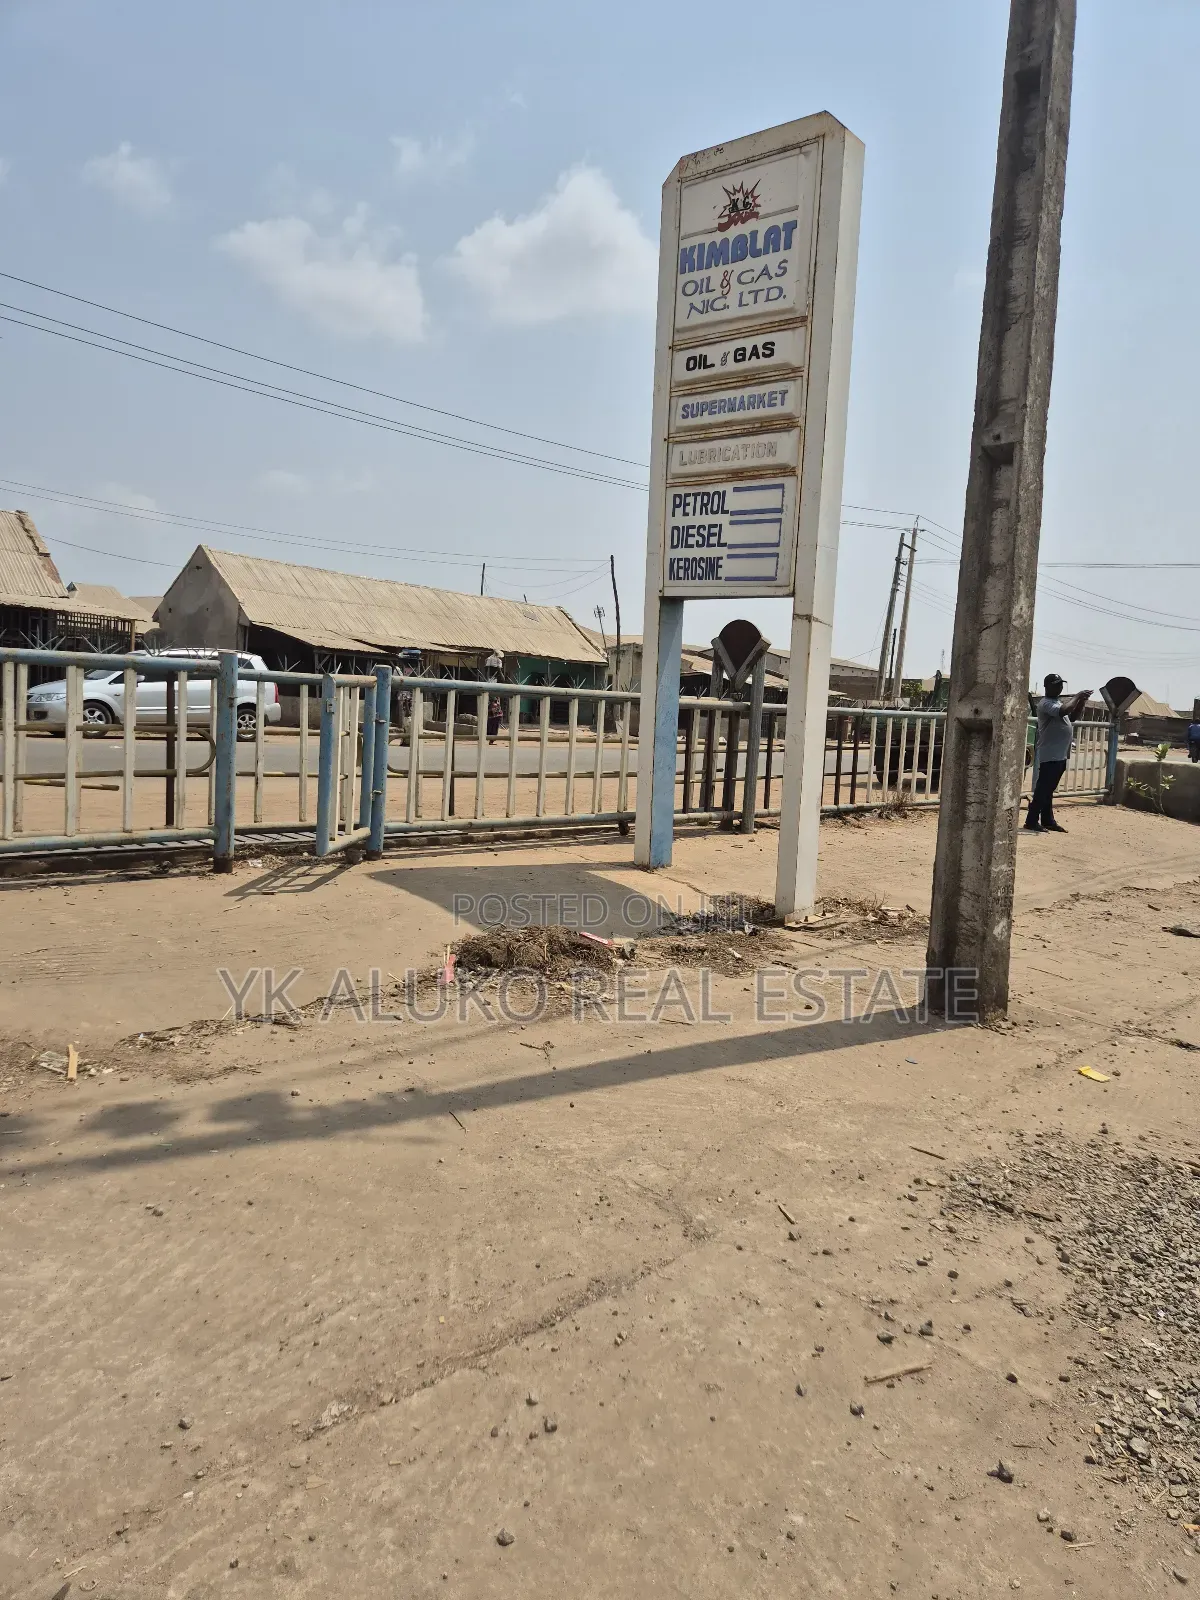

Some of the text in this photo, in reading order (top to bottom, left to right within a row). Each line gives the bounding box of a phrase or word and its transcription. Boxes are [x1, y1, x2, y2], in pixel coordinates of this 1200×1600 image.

[679, 219, 798, 275] KIMBLAT
[681, 258, 789, 297] OIL & GAS
[738, 285, 787, 308] LTD.
[685, 353, 715, 372] OIL
[733, 341, 776, 364] GAS
[681, 389, 789, 420] SUPERMARKET
[678, 441, 778, 467] LUBRICATION
[671, 490, 730, 518] PETROL
[670, 523, 728, 550] DIESEL
[668, 556, 724, 581] KEROSINE
